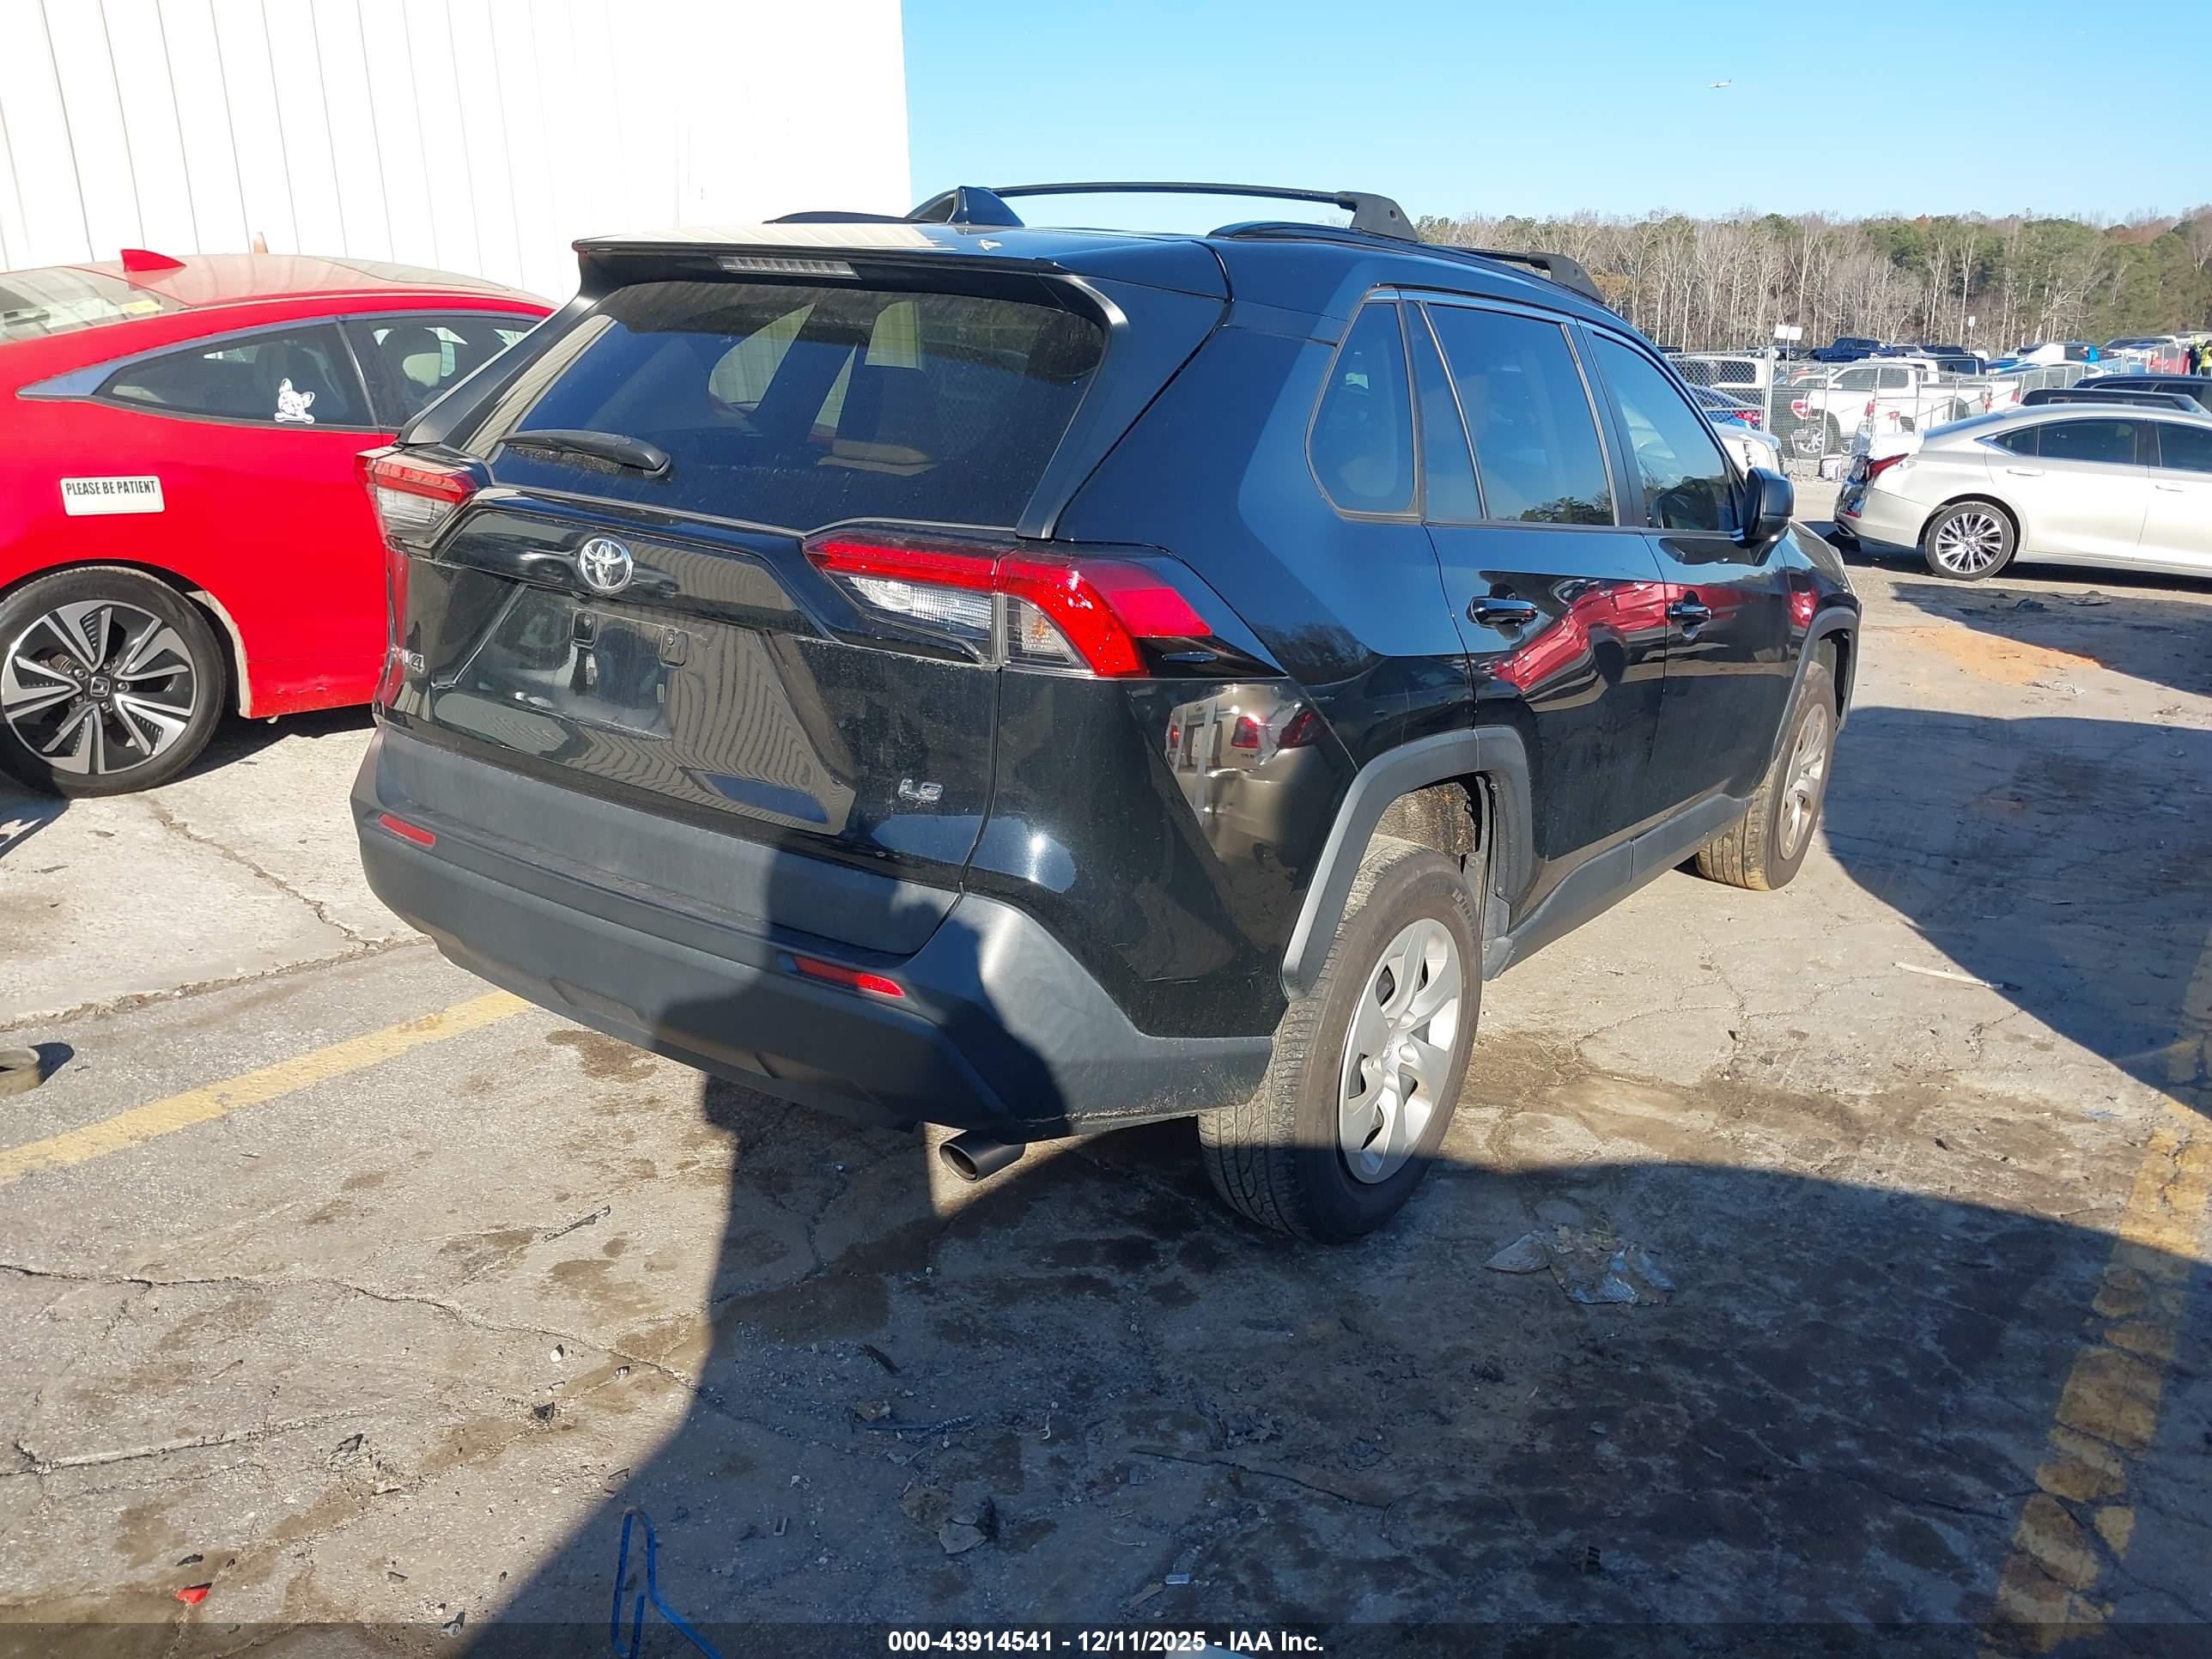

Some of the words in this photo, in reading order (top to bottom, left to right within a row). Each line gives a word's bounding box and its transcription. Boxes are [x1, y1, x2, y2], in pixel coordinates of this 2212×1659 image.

[65, 482, 101, 495] PLEASE
[102, 482, 116, 495] BE
[117, 480, 155, 494] PATIENT
